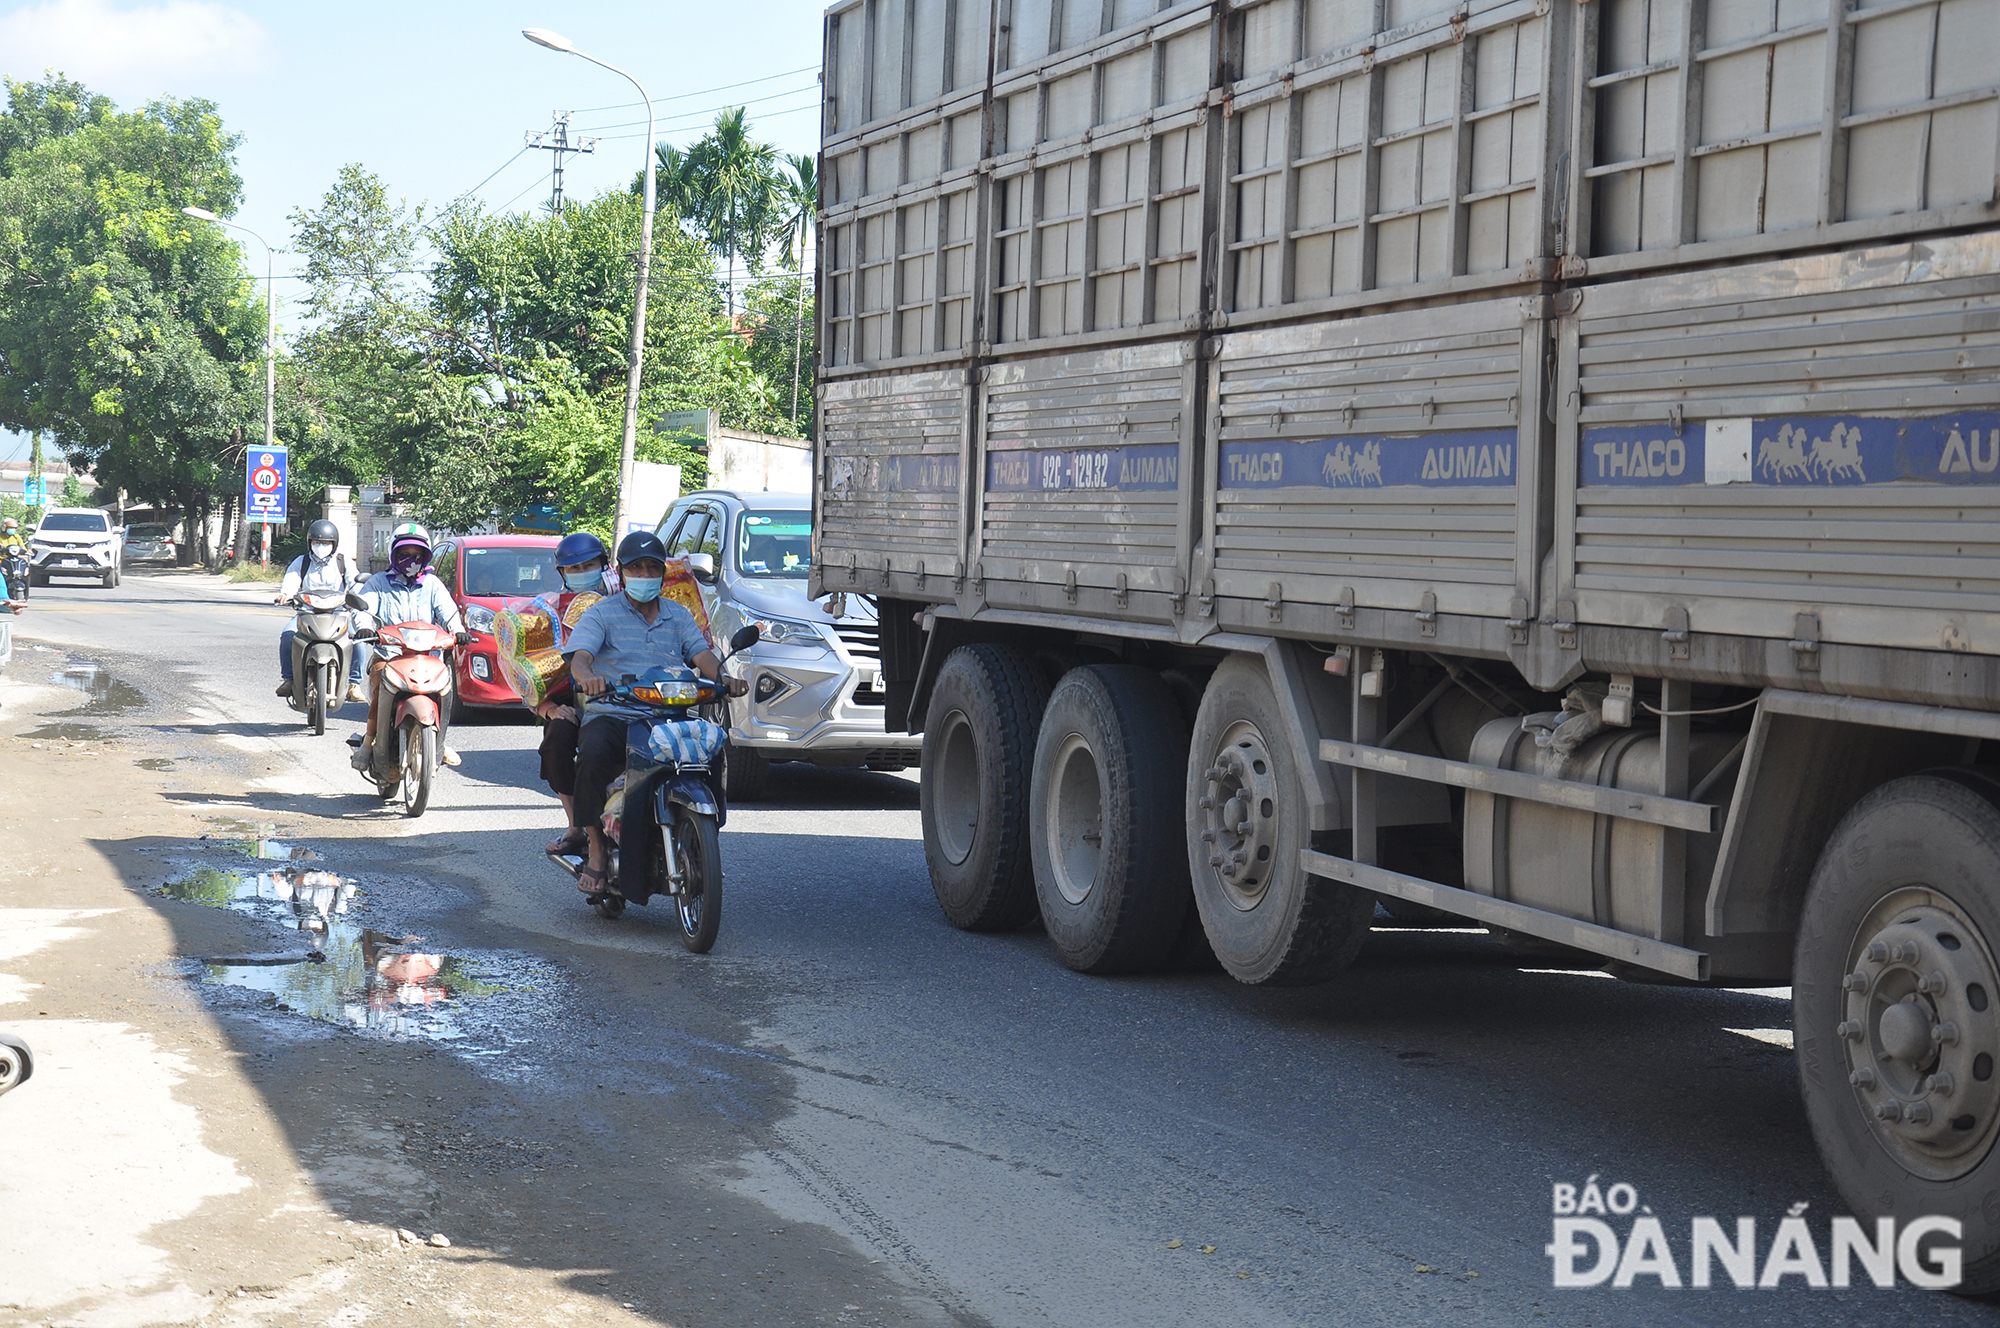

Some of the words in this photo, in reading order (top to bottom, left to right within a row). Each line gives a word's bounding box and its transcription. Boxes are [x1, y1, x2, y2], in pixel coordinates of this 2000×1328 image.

[993, 461, 1030, 485] THACO
[1043, 455, 1062, 489] 92C
[1074, 453, 1108, 488] 129.32
[1119, 456, 1177, 484] AUMAN
[1228, 452, 1283, 482] THACO
[1421, 444, 1511, 479] AUMAN
[1593, 438, 1686, 478] THACO
[259, 474, 271, 486] 40
